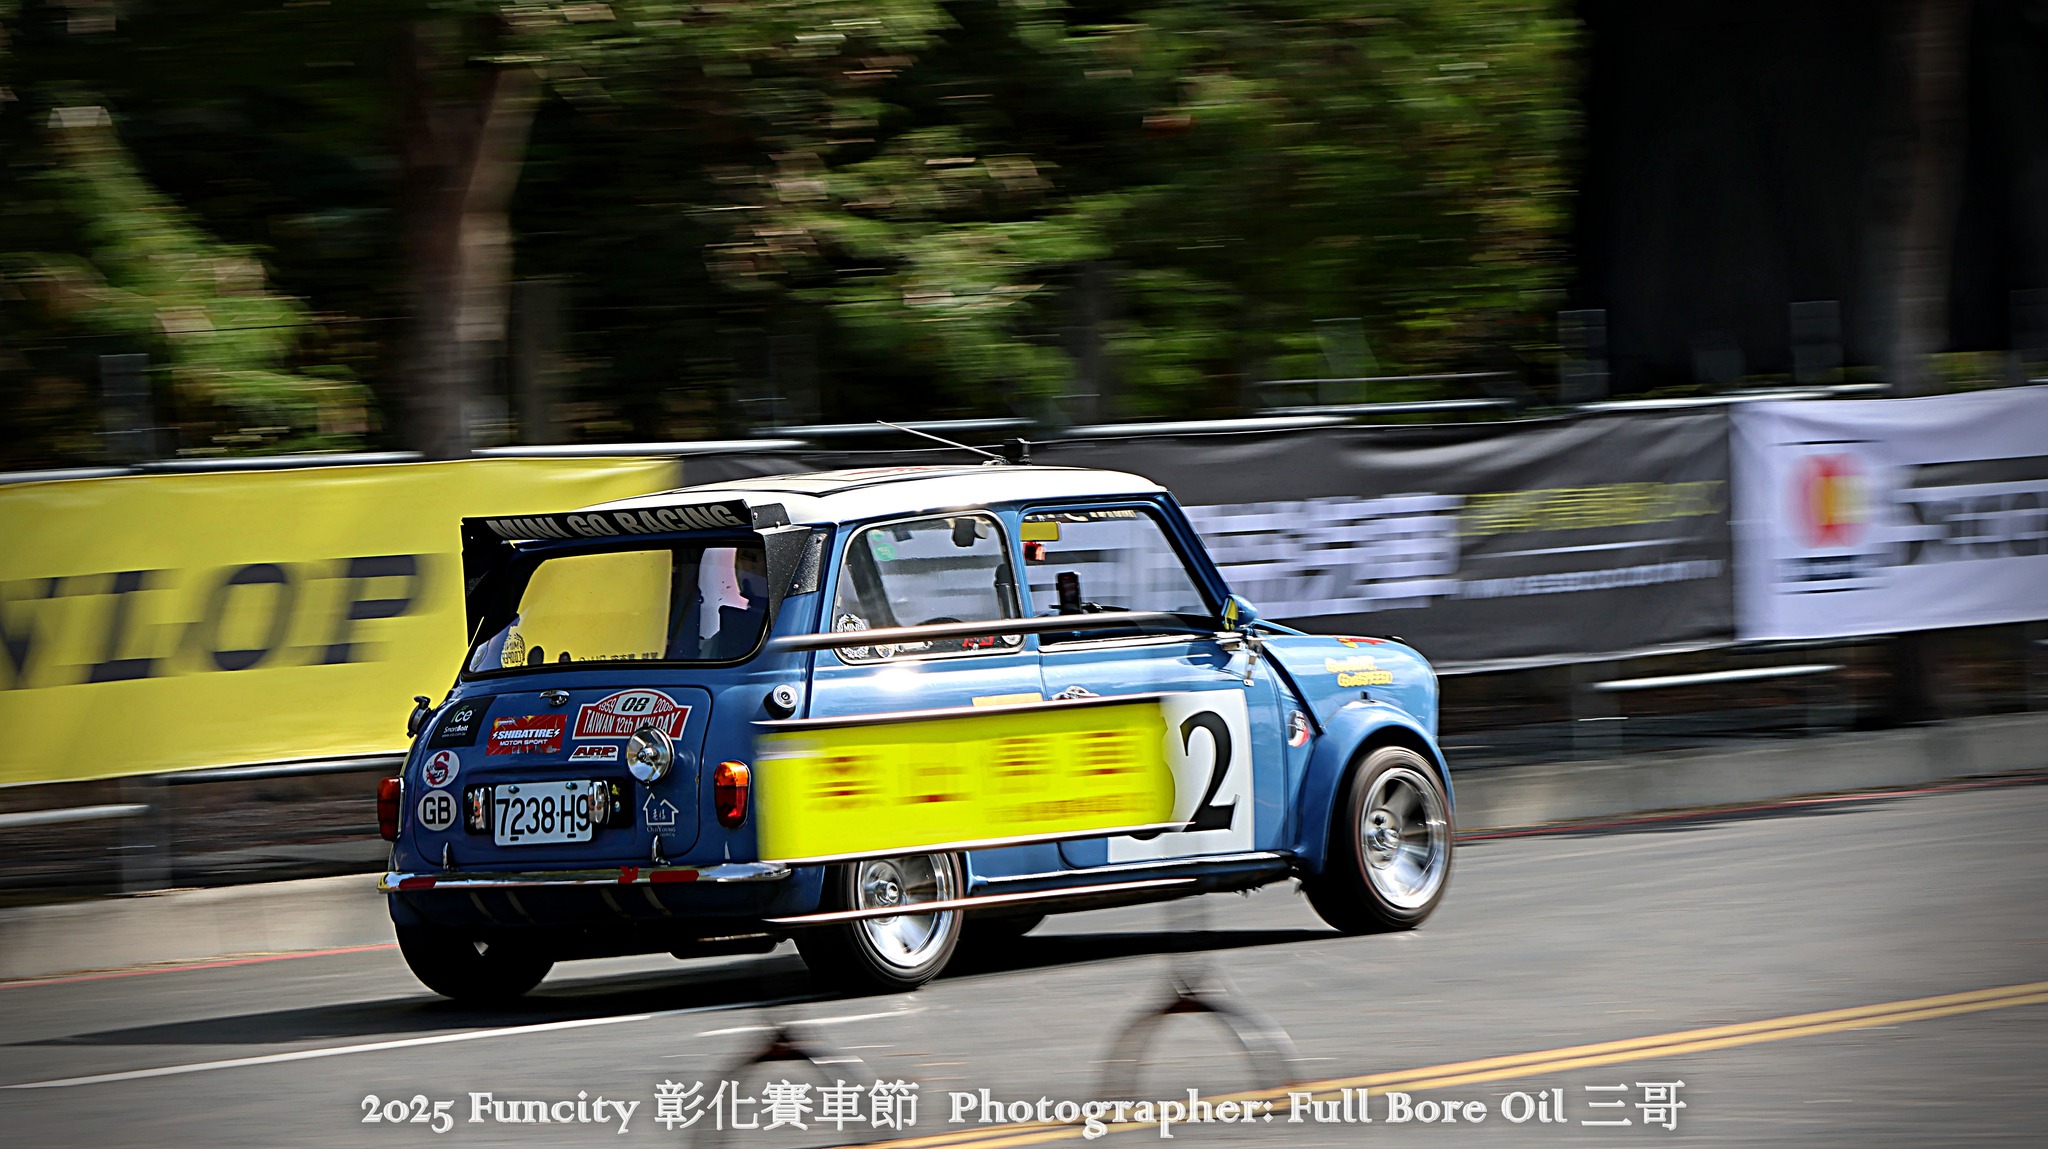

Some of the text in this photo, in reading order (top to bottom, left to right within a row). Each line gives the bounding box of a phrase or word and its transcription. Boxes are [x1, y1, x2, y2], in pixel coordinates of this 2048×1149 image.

[486, 504, 747, 539] MINI GO RACING
[621, 697, 650, 712] 08
[582, 709, 616, 734] TAIWAN
[615, 717, 634, 733] 12th
[655, 710, 682, 735] DAY
[497, 728, 555, 740] SHIBATIRE
[499, 738, 549, 747] MOTOR SPORT
[573, 746, 617, 756] ARP
[422, 796, 452, 825] GB
